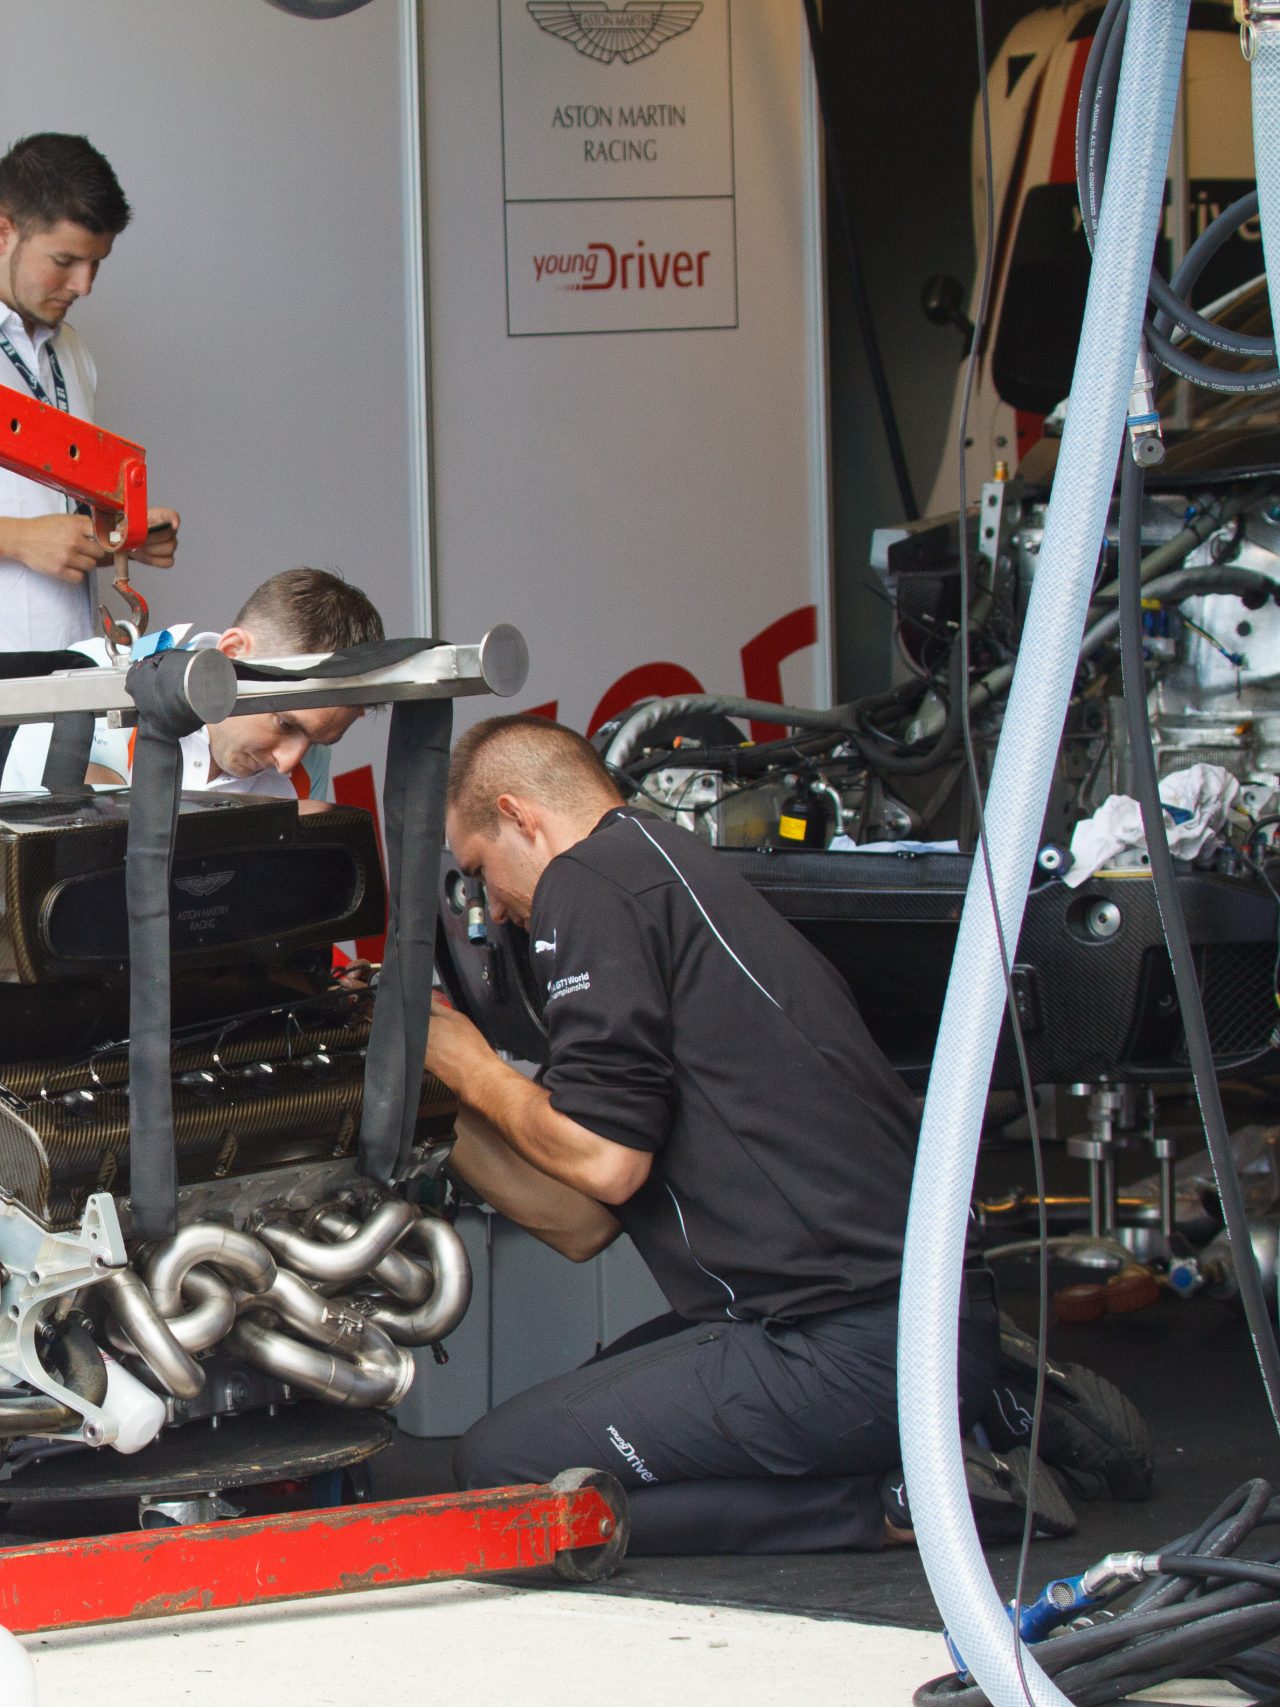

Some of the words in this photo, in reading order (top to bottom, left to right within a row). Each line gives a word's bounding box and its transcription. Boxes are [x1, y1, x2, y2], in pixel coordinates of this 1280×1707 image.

[582, 14, 613, 26] ASTON
[552, 105, 613, 128] ASTON
[619, 104, 686, 127] MARTIN
[584, 139, 658, 162] RACING
[567, 971, 590, 986] World
